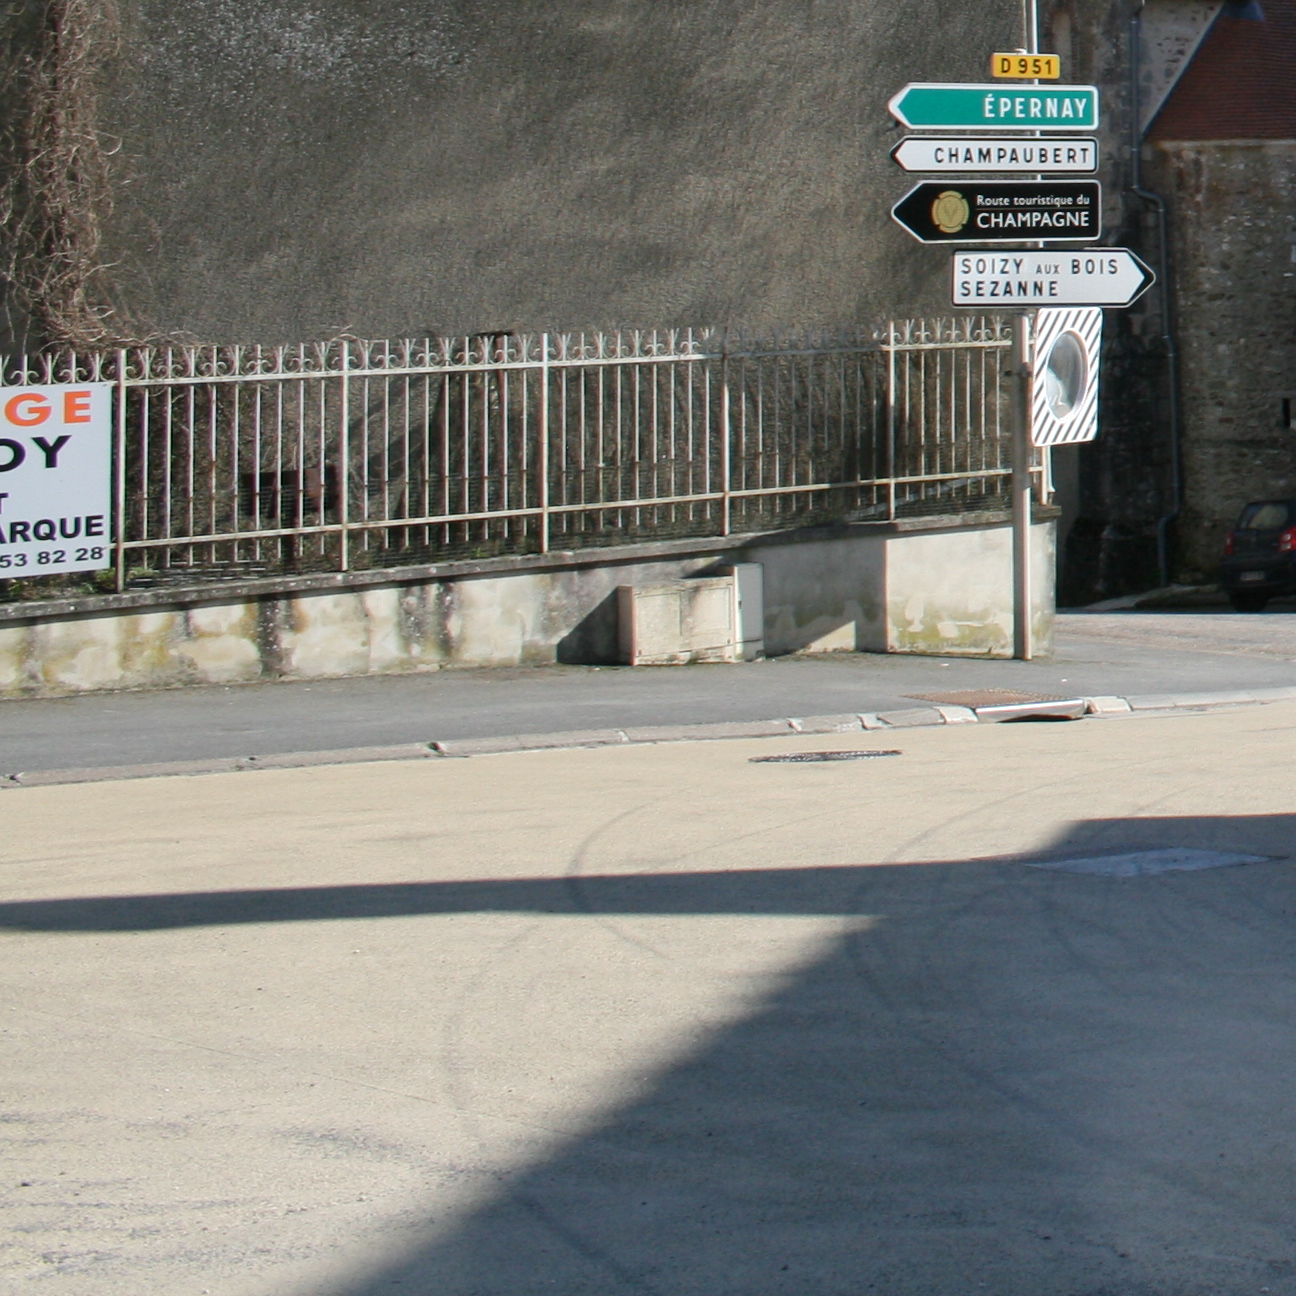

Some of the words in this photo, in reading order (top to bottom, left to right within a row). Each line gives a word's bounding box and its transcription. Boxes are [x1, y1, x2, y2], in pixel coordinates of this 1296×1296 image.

[1001, 58, 1011, 74] D
[1018, 58, 1052, 75] 951
[984, 93, 1087, 118] ÉPERNAY
[934, 147, 1089, 164] CHAMPAUBERT
[976, 194, 1010, 206] Route
[1013, 194, 1073, 208] touristique
[1076, 194, 1090, 205] du
[976, 211, 1090, 229] CHAMPAGNE
[960, 258, 1024, 275] SOIZY
[1035, 264, 1061, 275] AUX
[1071, 258, 1118, 275] BOIS
[960, 280, 1059, 297] SEZANNE
[4, 391, 92, 427] GE
[0, 553, 28, 569] 53
[37, 550, 67, 565] 82
[75, 546, 104, 562] 28
